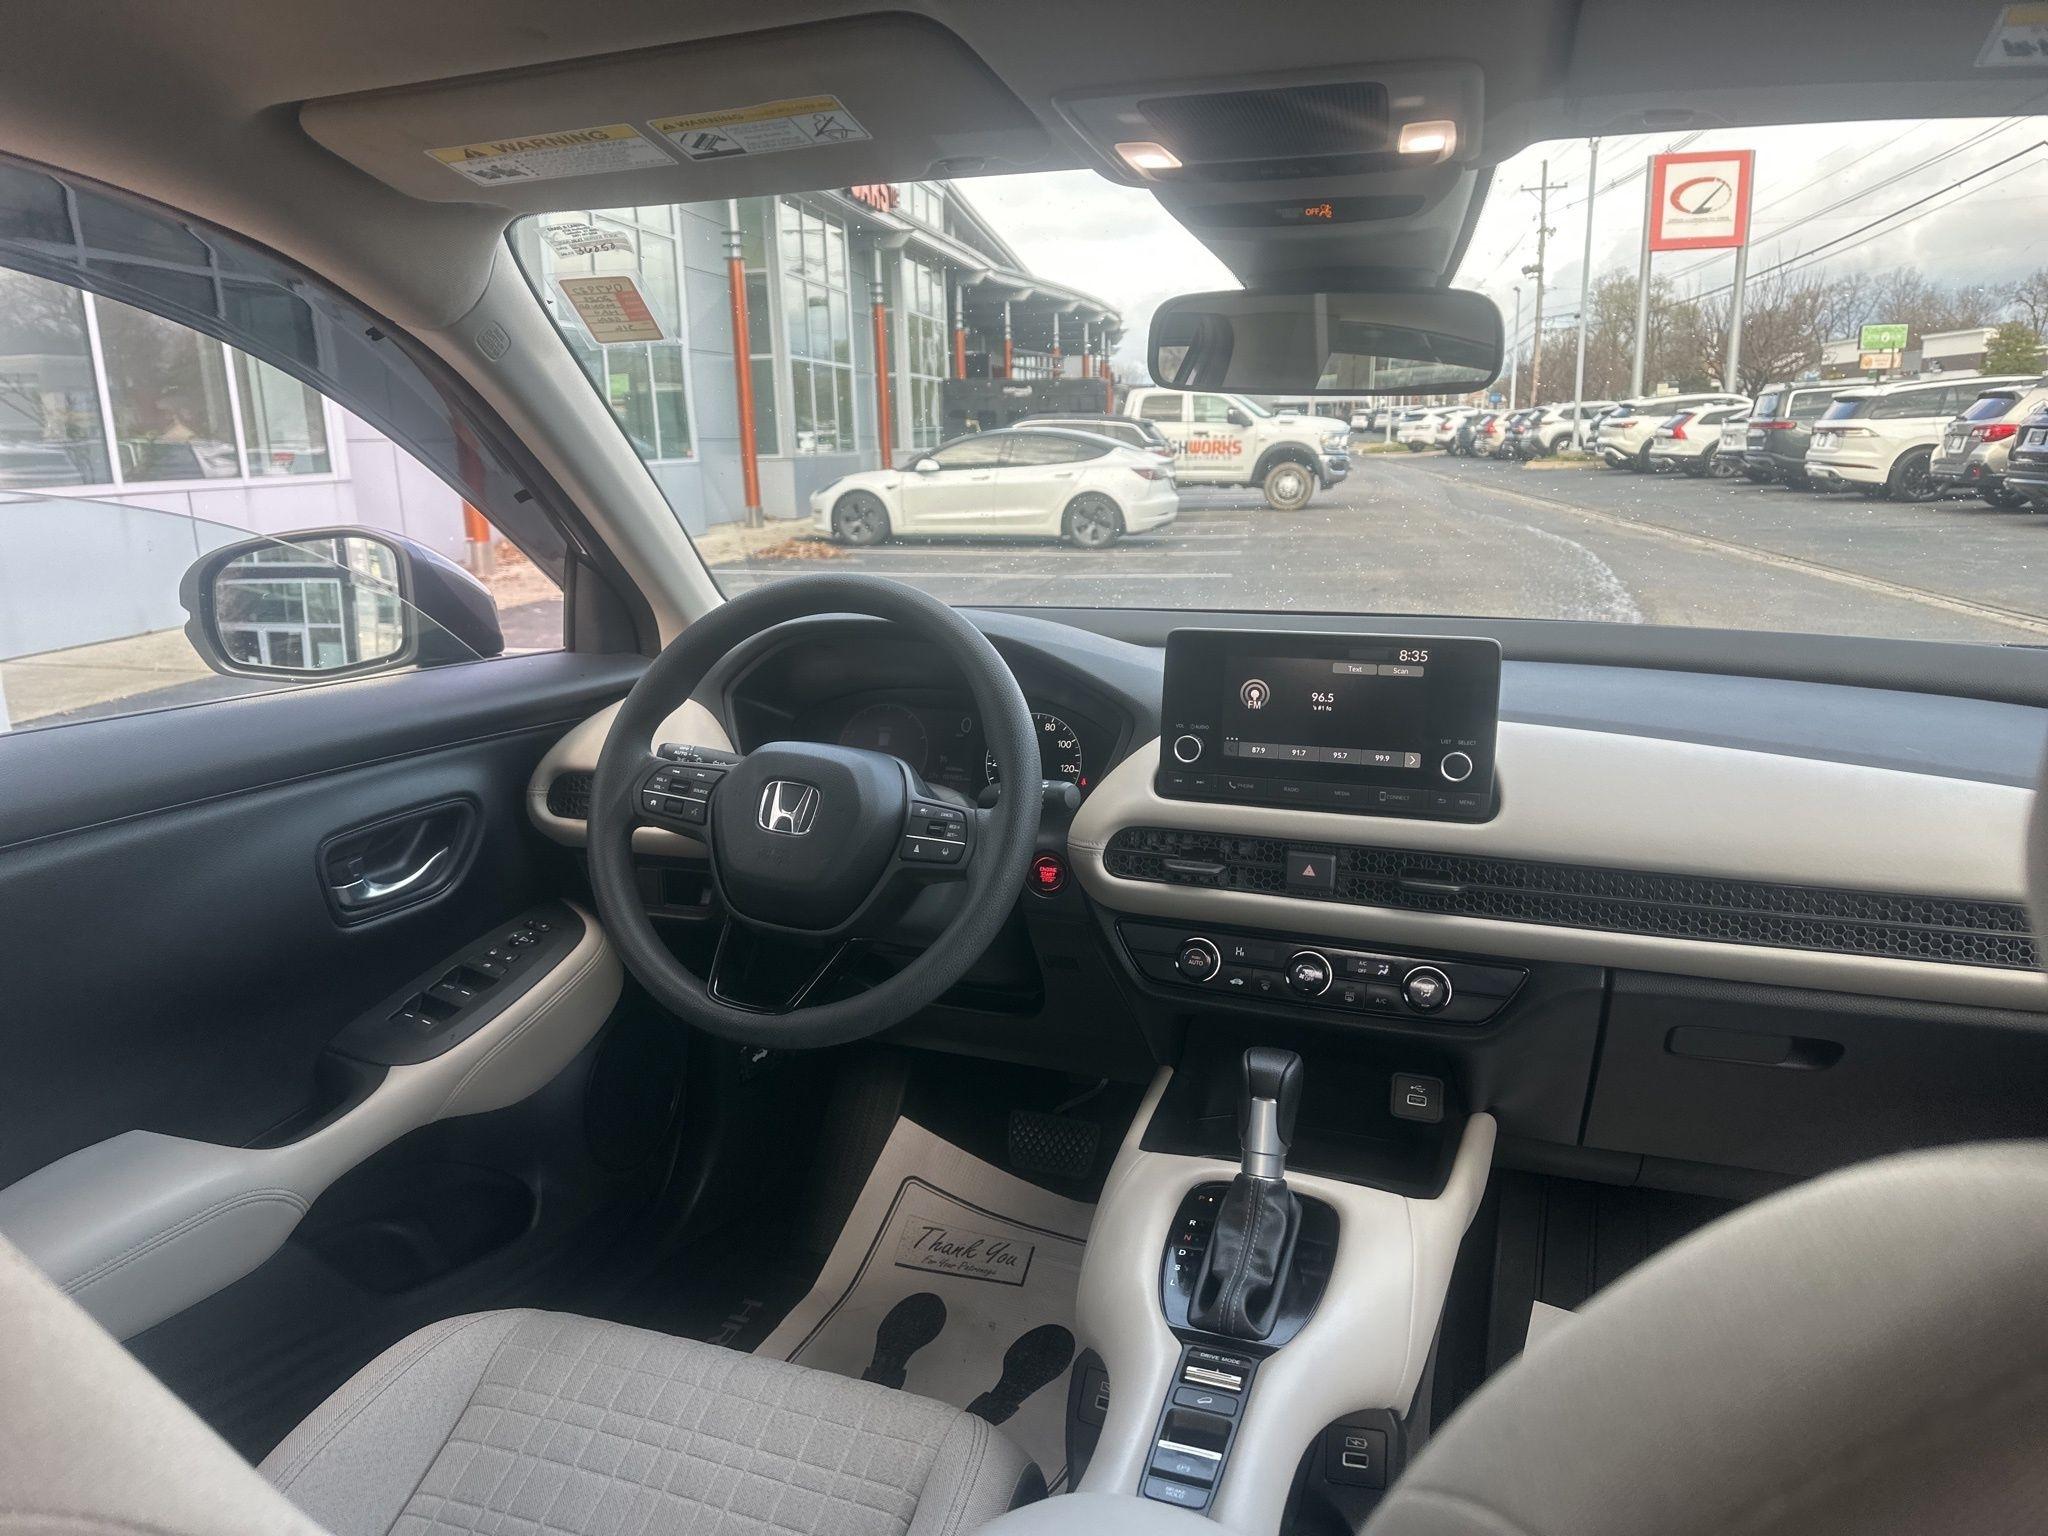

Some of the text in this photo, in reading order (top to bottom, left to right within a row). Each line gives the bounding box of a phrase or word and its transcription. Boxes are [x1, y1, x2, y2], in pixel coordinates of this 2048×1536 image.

[491, 130, 610, 153] WARNING
[1305, 207, 1320, 216] OFF
[1399, 650, 1428, 662] 8:35
[1348, 665, 1362, 673] Text
[1311, 692, 1334, 703] 96.5
[1247, 699, 1261, 710] FM
[961, 717, 972, 733] 0
[1044, 723, 1056, 732] 80
[1057, 740, 1072, 749] 100
[1251, 746, 1266, 754] 87.9
[1291, 749, 1306, 757] 91.7
[1375, 754, 1390, 762] 99.9
[1060, 764, 1075, 773] 120
[1188, 959, 1203, 967] AUTO
[1375, 997, 1388, 1005] A/C
[914, 1226, 1018, 1267] Thank You
[1200, 1352, 1240, 1365] DRIVE MODE
